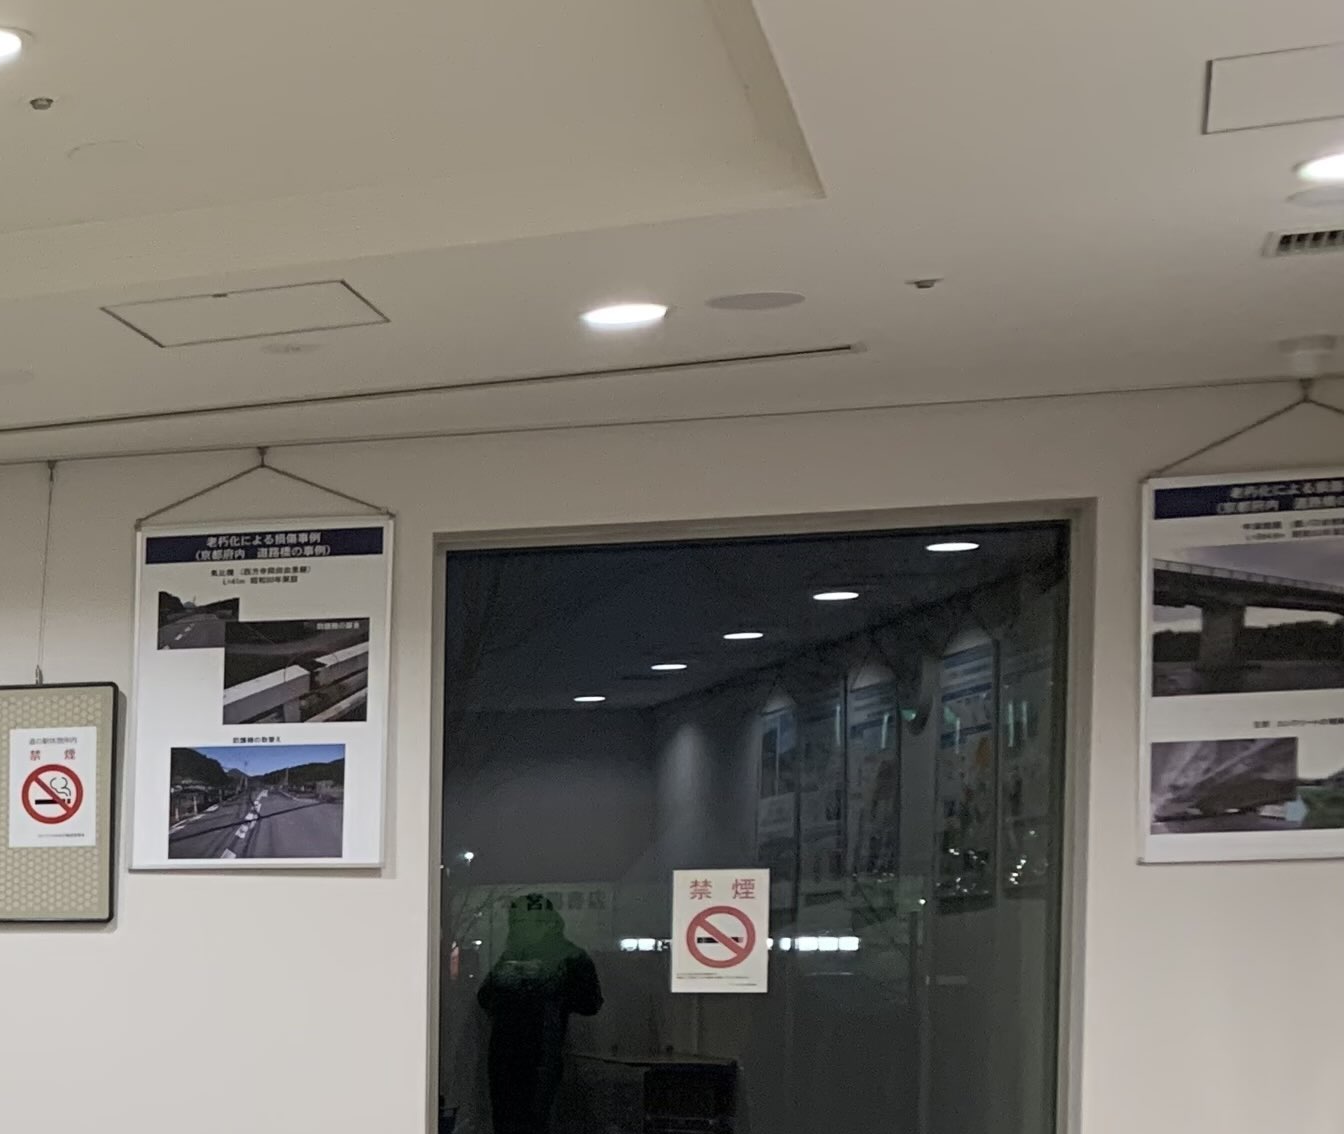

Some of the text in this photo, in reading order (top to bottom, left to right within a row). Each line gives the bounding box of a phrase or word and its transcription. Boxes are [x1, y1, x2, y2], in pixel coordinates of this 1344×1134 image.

[206, 531, 322, 548] 老朽化による損傷事例
